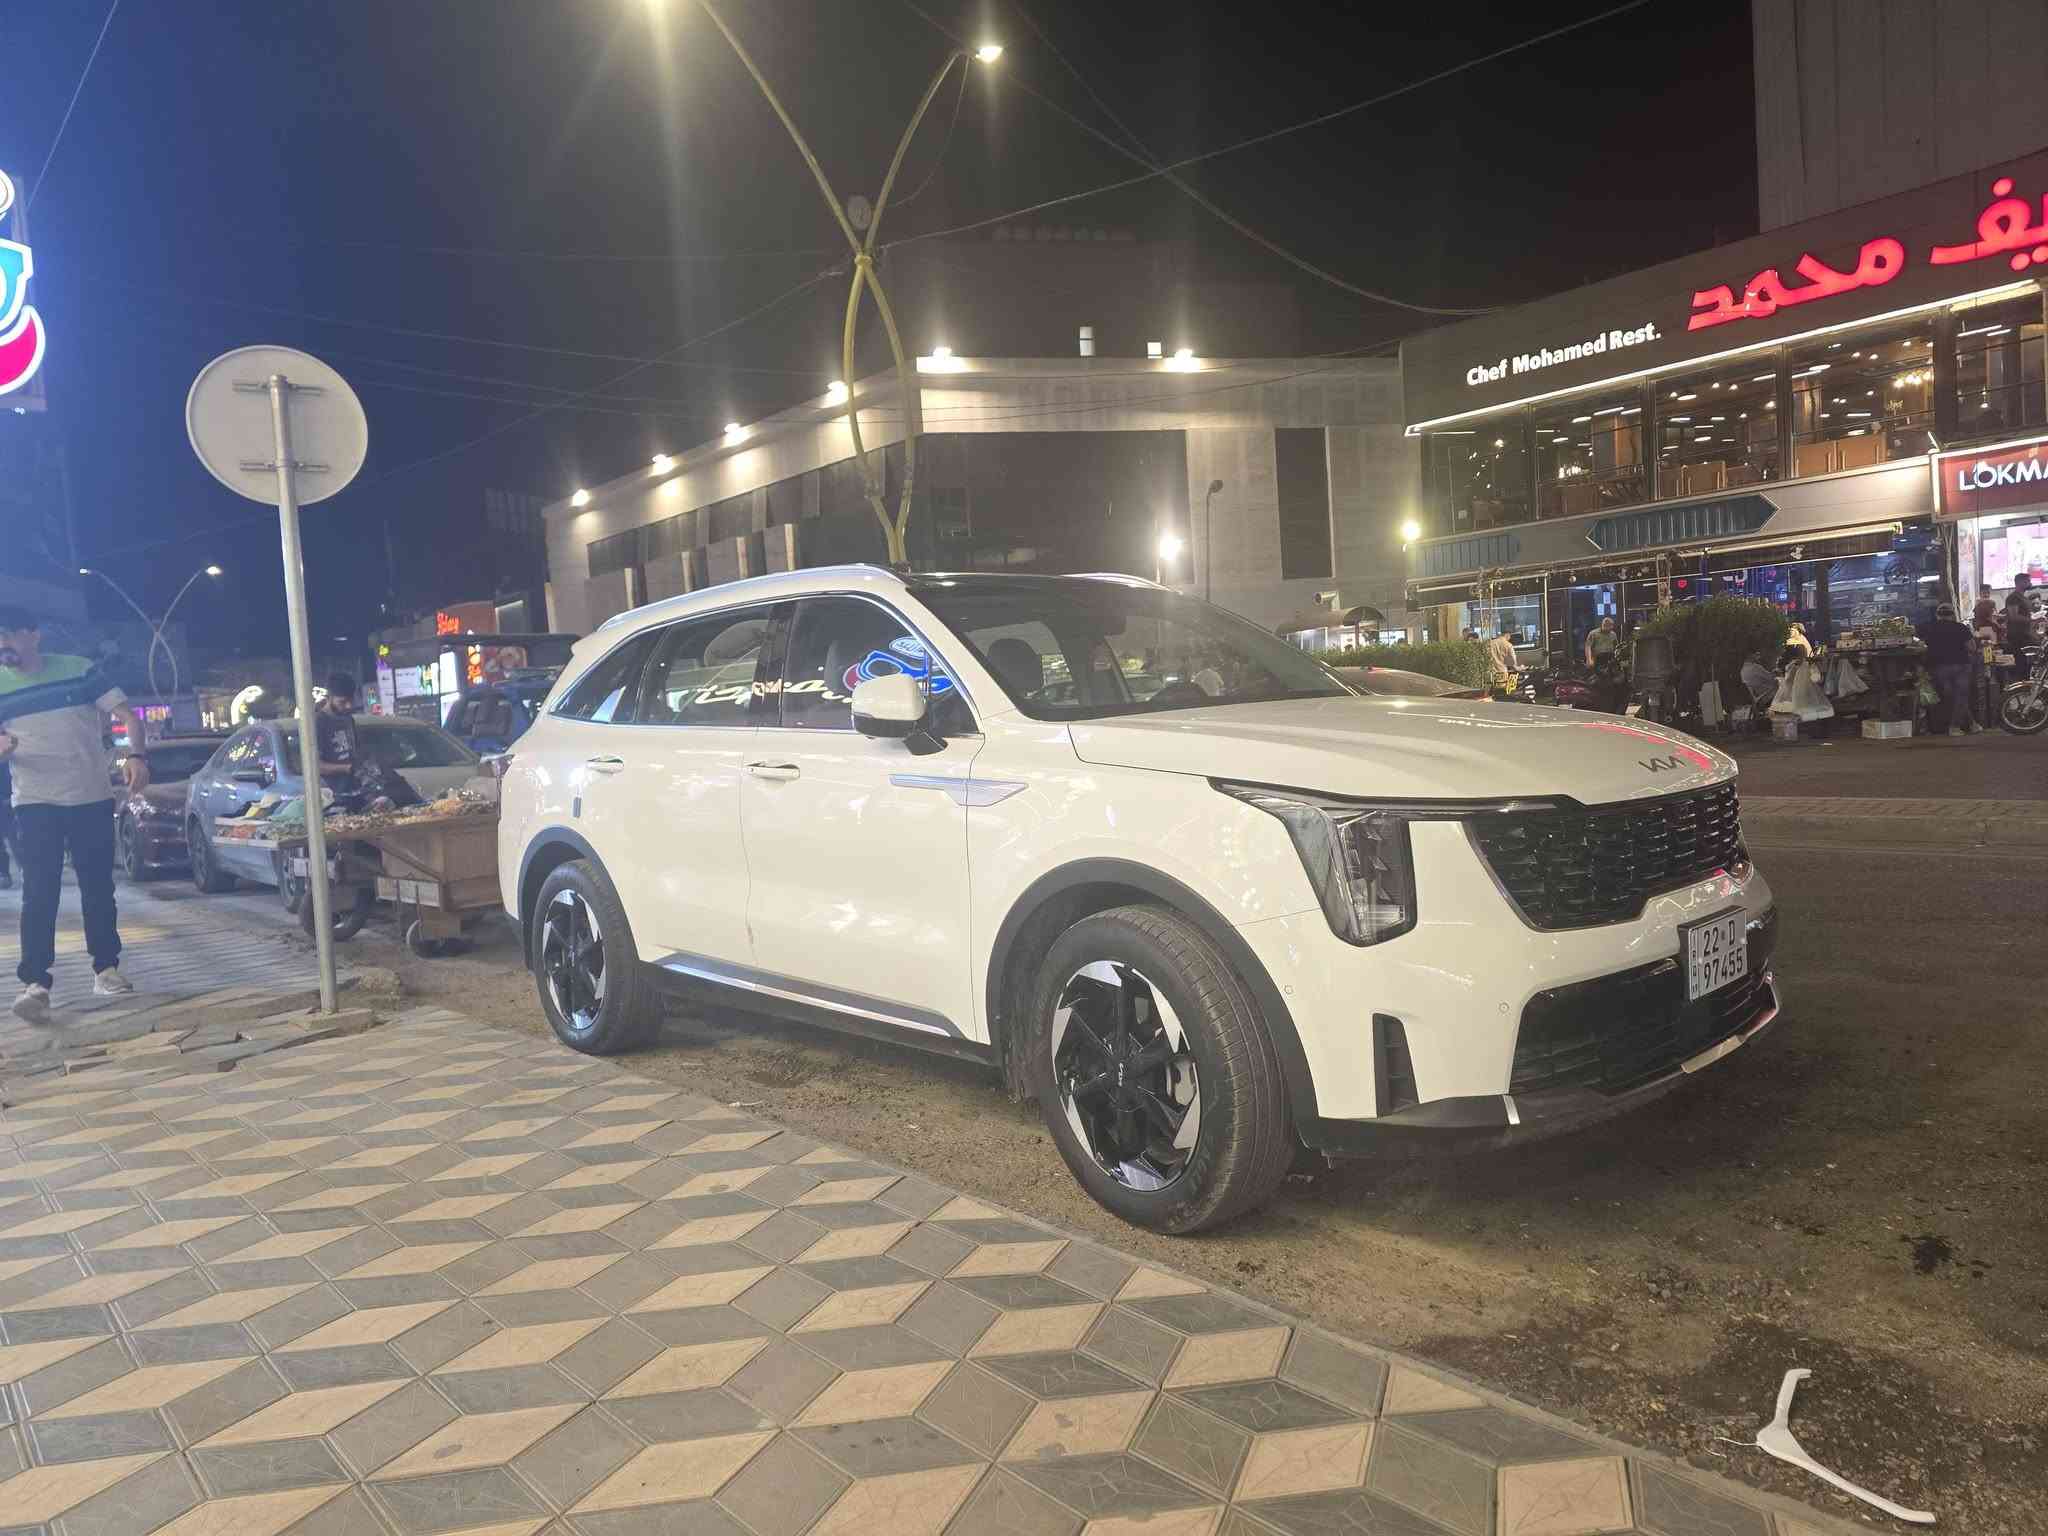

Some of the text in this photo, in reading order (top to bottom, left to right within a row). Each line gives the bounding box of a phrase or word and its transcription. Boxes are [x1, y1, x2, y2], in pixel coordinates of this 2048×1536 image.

[1687, 237, 1905, 331] محمد
[1466, 322, 1661, 386] Chef Mohamed Rest.
[1703, 919, 1736, 957] 22 D
[1703, 947, 1744, 989] 97455
